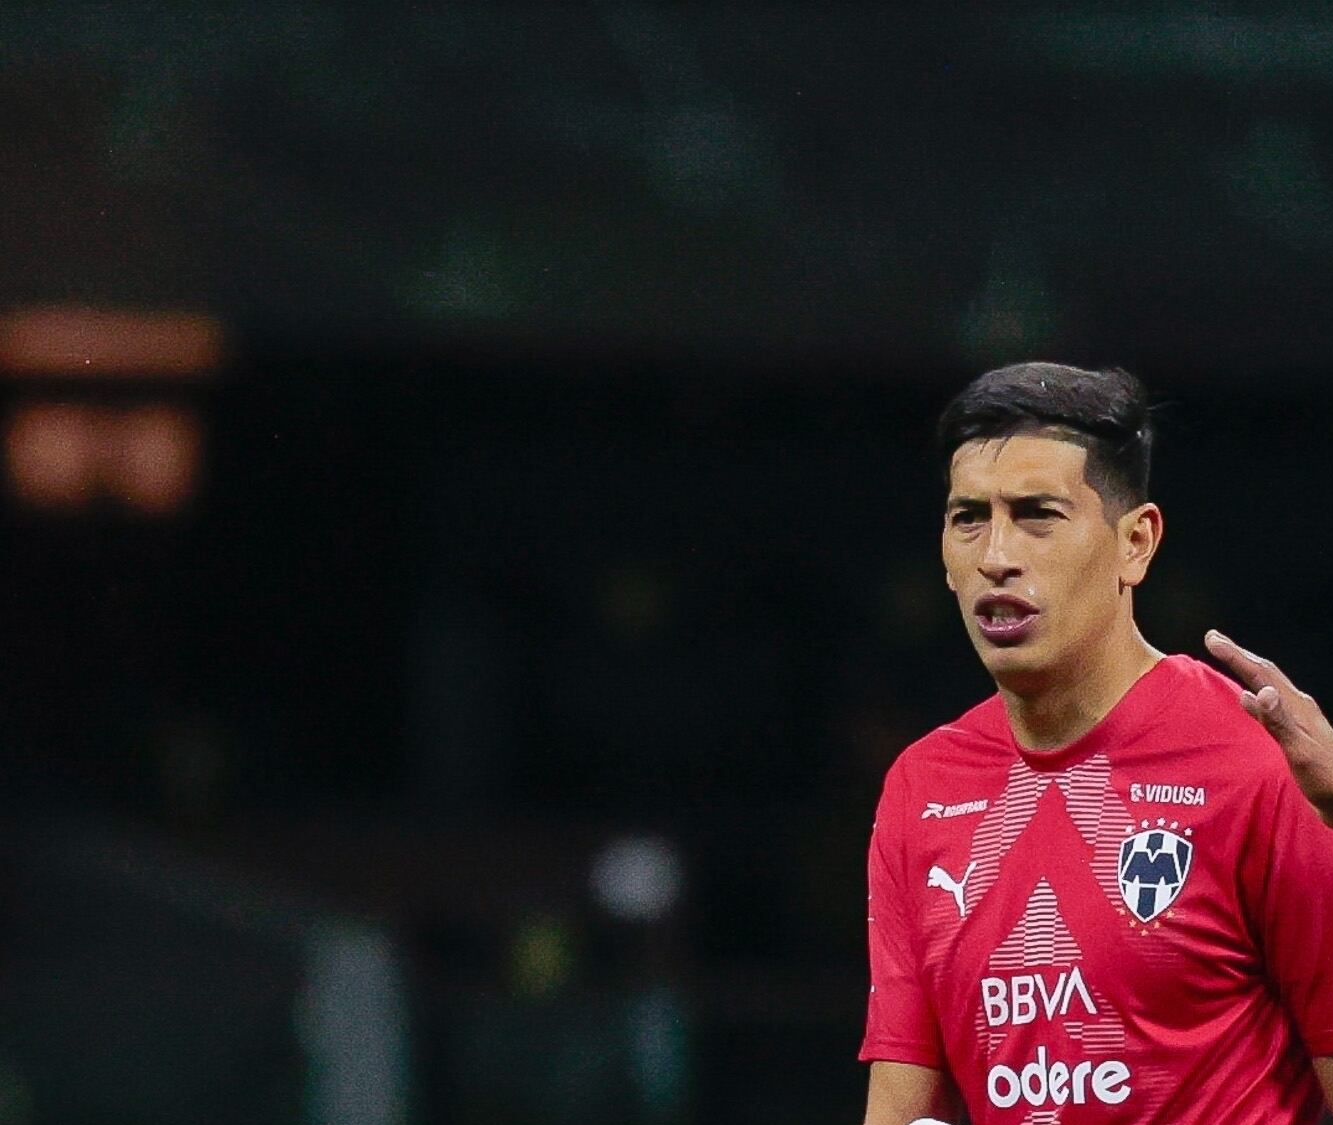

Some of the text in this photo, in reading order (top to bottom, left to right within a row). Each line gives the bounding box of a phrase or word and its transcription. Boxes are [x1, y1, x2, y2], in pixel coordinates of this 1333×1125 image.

[1144, 784, 1206, 806] VIDUSA
[981, 966, 1098, 1027] BBVA
[987, 1046, 1132, 1108] odere
